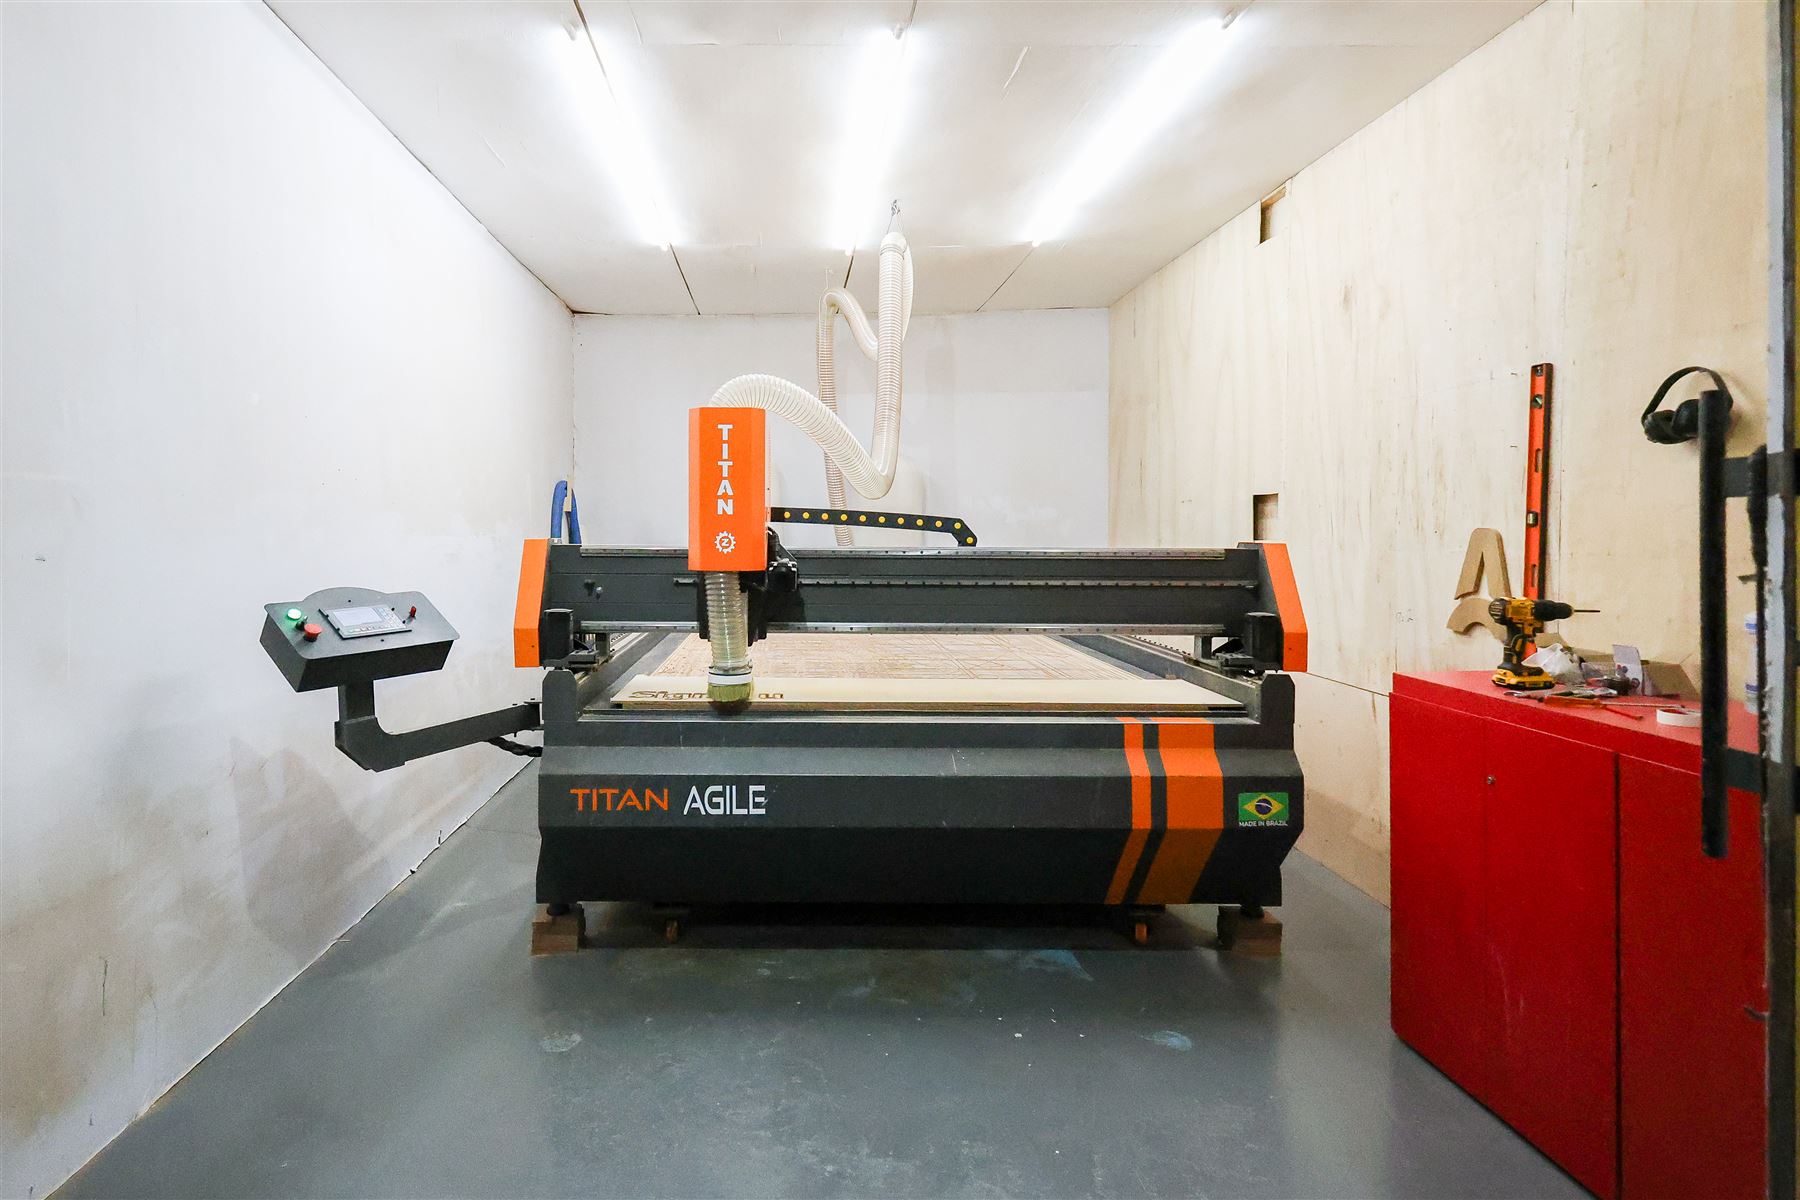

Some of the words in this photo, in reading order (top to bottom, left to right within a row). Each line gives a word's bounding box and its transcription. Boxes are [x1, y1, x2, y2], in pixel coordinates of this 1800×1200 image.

[717, 424, 733, 514] TITAN
[569, 787, 669, 811] TITAN
[683, 784, 767, 815] AGILE
